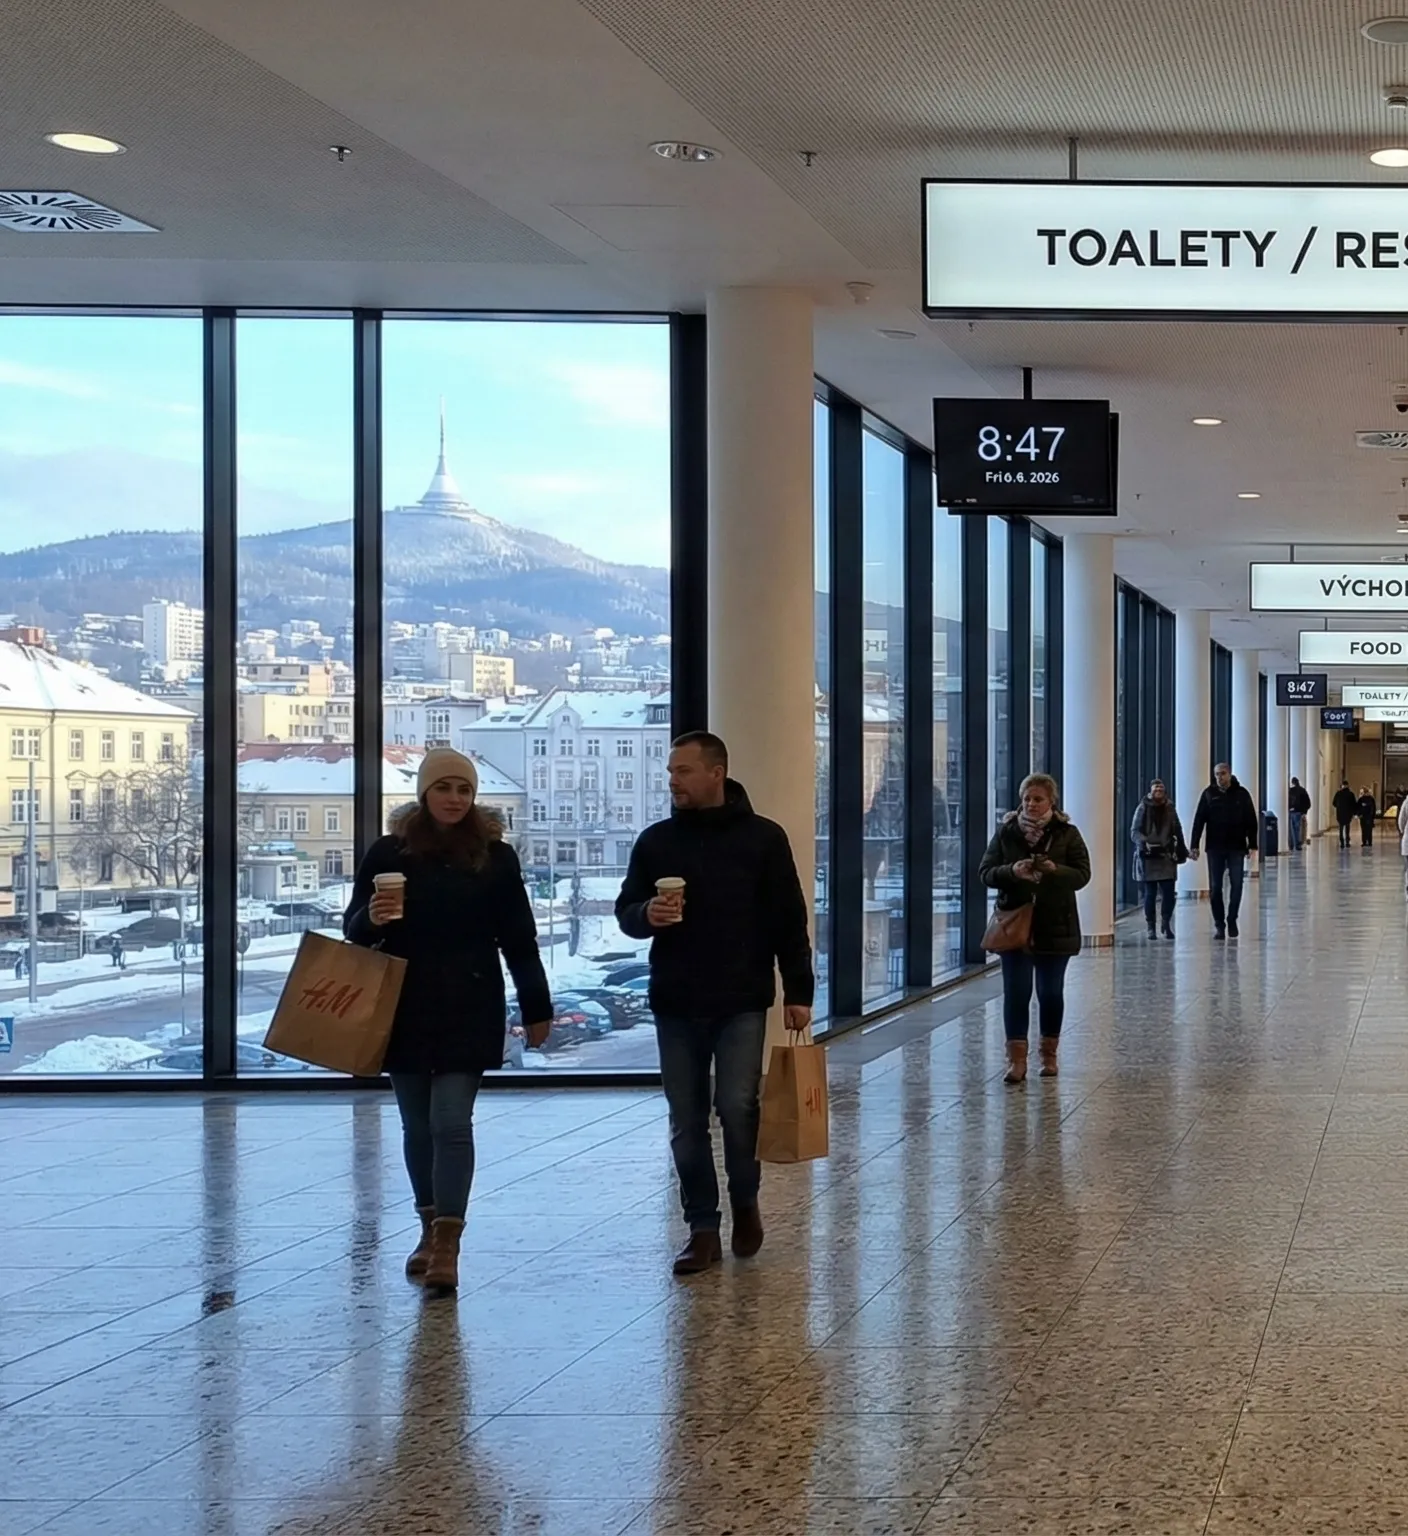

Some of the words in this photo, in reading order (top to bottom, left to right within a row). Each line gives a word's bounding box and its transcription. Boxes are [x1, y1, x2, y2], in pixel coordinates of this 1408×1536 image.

[1036, 227, 1278, 269] TOALETY
[1289, 226, 1318, 275] /
[977, 425, 1066, 462] 8:47
[985, 471, 1003, 484] Fri
[1029, 471, 1060, 484] 2026
[1350, 641, 1402, 656] FOOD
[297, 977, 364, 1019] H&M
